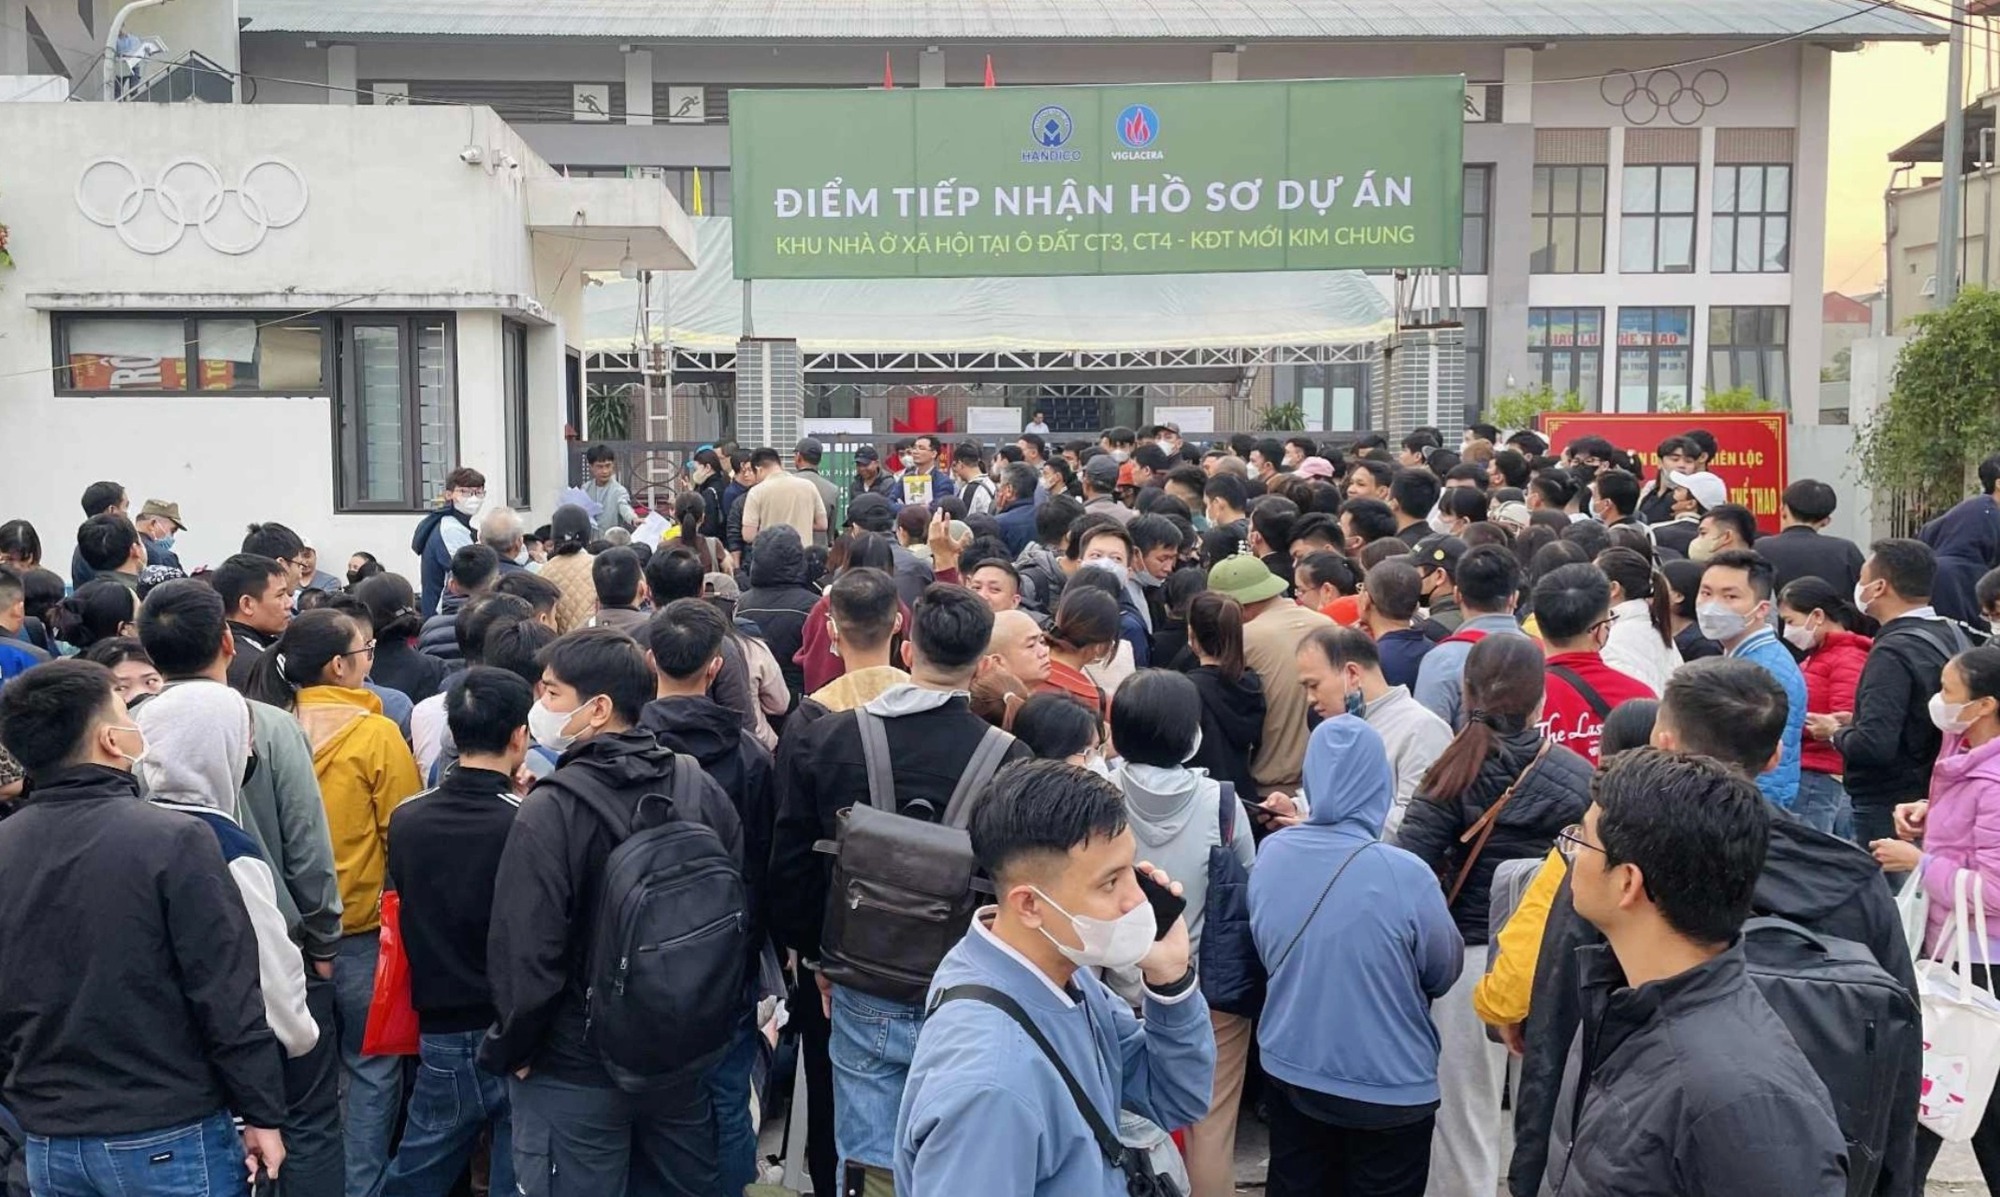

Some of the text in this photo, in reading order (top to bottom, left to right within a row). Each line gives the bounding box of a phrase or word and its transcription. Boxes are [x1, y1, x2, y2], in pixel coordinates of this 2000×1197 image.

[1022, 150, 1082, 162] HANDICO
[1111, 150, 1164, 161] VIGLACERA
[774, 169, 1412, 222] ĐIỂM TIẾP NHẬN HỒ SƠ DỰ ÁN
[776, 235, 822, 255] KHU
[828, 231, 875, 254] NHÀ
[902, 231, 931, 254] XÃ
[936, 230, 974, 257] HỘI
[978, 234, 1010, 257] TẠI
[1015, 230, 1033, 252] Ô
[1037, 228, 1080, 252] ĐẤT
[1084, 233, 1128, 253] CT3,
[1133, 232, 1172, 250] CT4
[1191, 230, 1234, 249] KĐT
[1239, 224, 1282, 248] MỚI
[1289, 227, 1328, 247] KIM
[1334, 225, 1415, 246] CHUNG
[1739, 449, 1764, 469] LỘC
[1751, 486, 1777, 515] THAO
[1533, 711, 1605, 743] The Las
